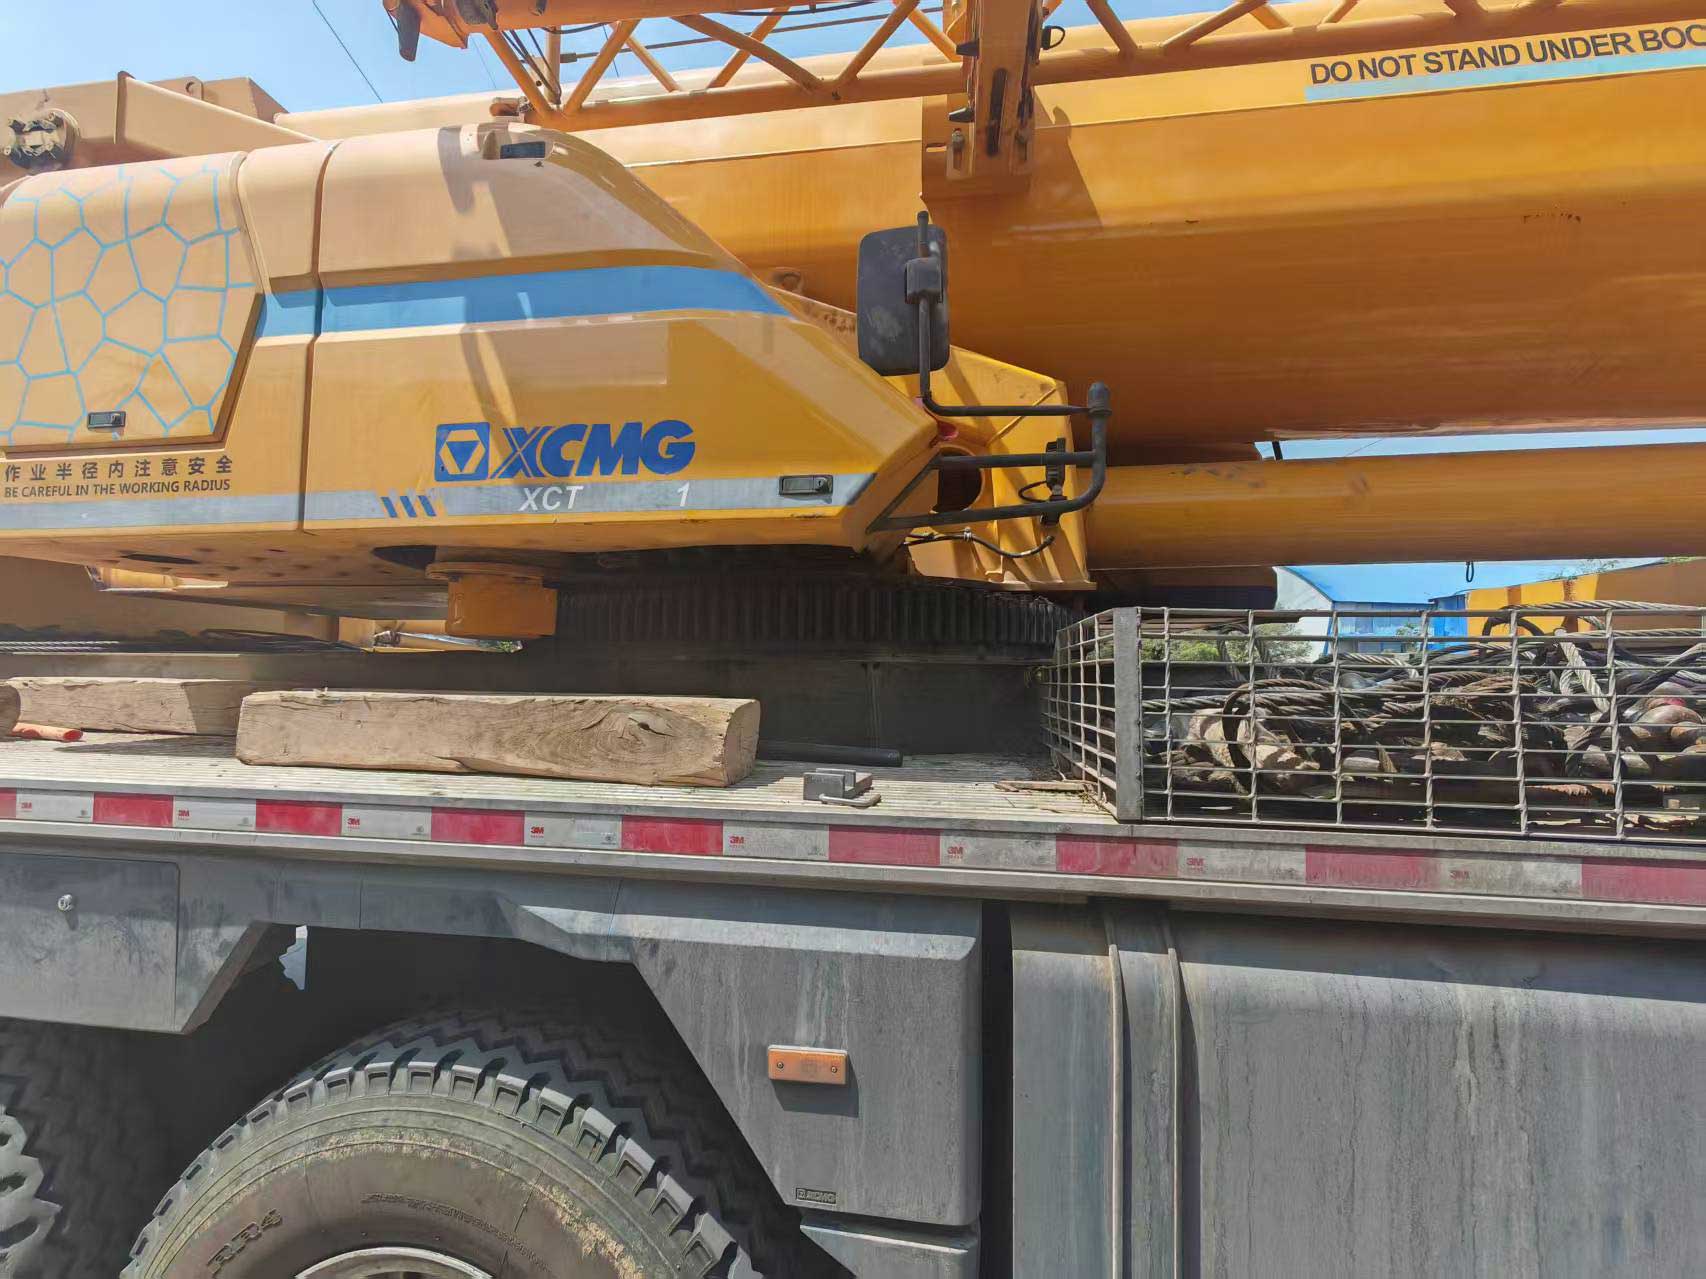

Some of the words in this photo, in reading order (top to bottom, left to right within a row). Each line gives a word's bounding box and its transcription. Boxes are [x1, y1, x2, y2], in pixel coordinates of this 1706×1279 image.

[1310, 61, 1353, 84] DO
[1358, 55, 1417, 81] NOT
[1423, 44, 1521, 74] STAND
[1526, 32, 1634, 64] UNDER
[490, 420, 695, 478] XCMG
[4, 455, 233, 482] 作业半径内注意安全
[4, 487, 18, 498] BE
[22, 484, 72, 497] CAREFUL
[75, 485, 89, 496] IN
[94, 483, 116, 495] THE
[119, 481, 180, 494] WORKING
[183, 479, 230, 491] RADIUS
[519, 486, 583, 511] XCT
[677, 482, 690, 507] 1
[178, 809, 190, 817] 3M
[347, 817, 361, 826] 3M
[530, 826, 545, 834] 3M
[729, 835, 745, 843] 3M
[947, 846, 964, 855] 3M
